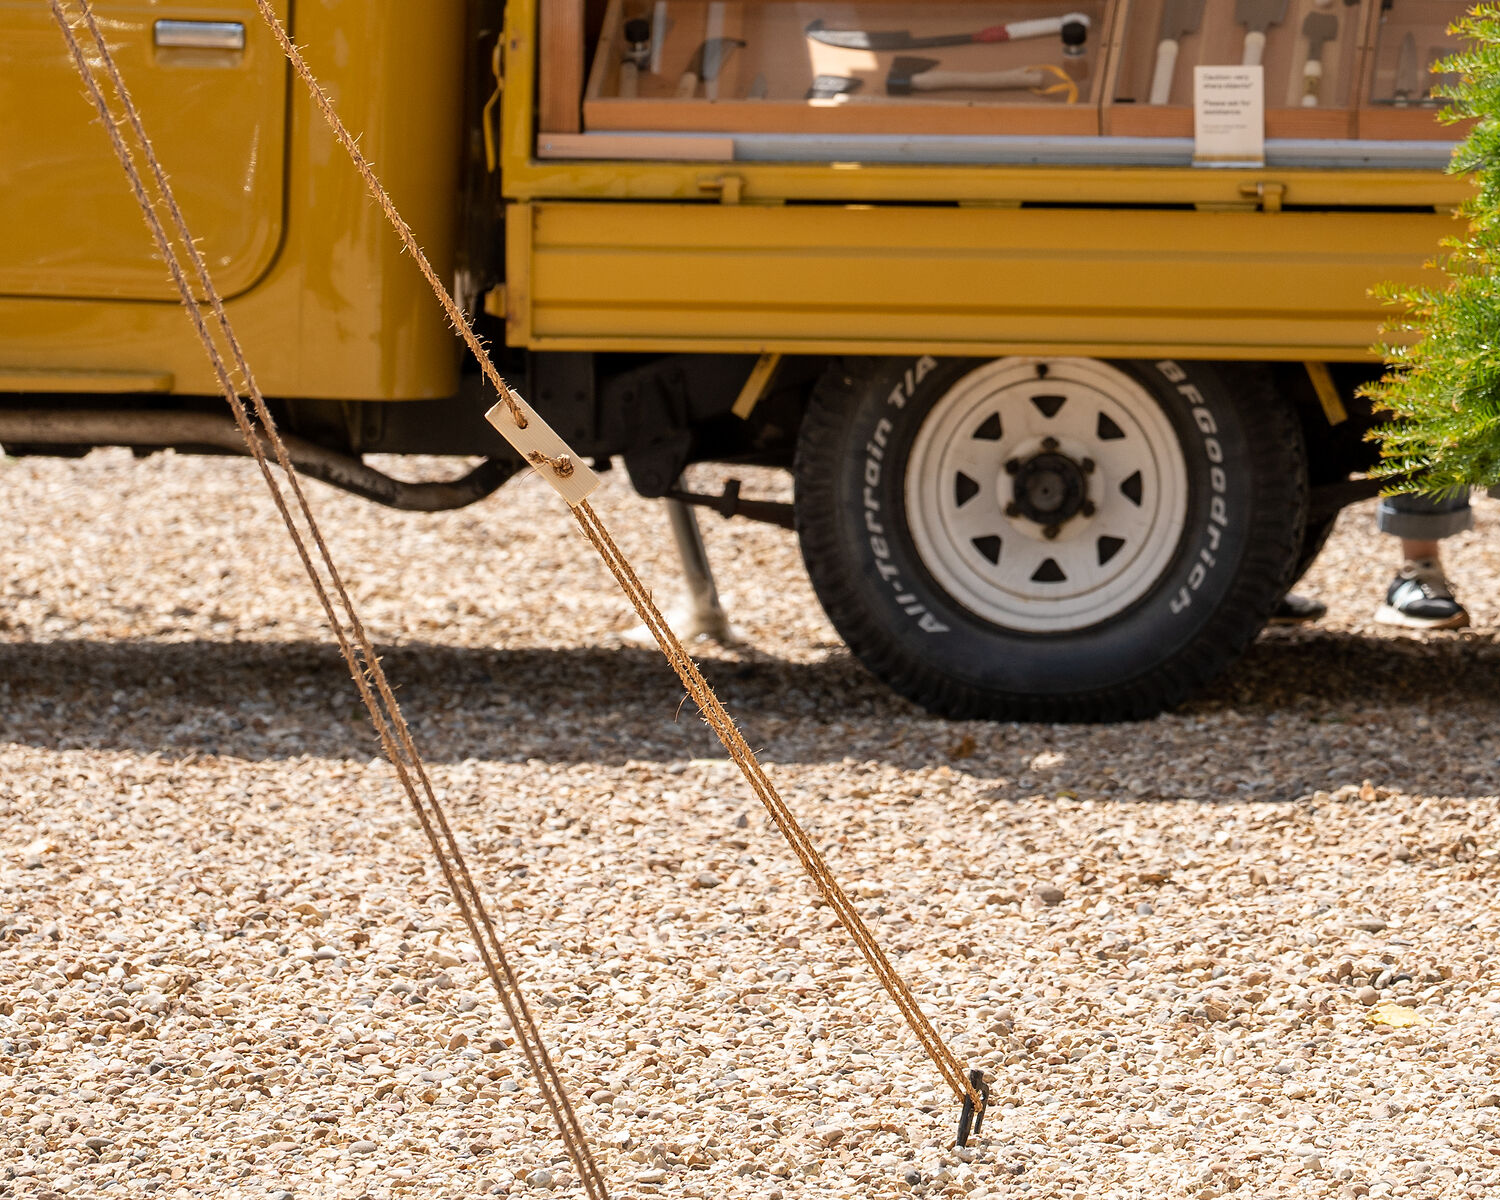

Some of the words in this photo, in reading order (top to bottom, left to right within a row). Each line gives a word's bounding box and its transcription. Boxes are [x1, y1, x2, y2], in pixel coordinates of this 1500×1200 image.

[887, 355, 938, 409] T/A
[1155, 359, 1228, 615] BFGoodrich
[863, 417, 951, 633] All-Terrain
